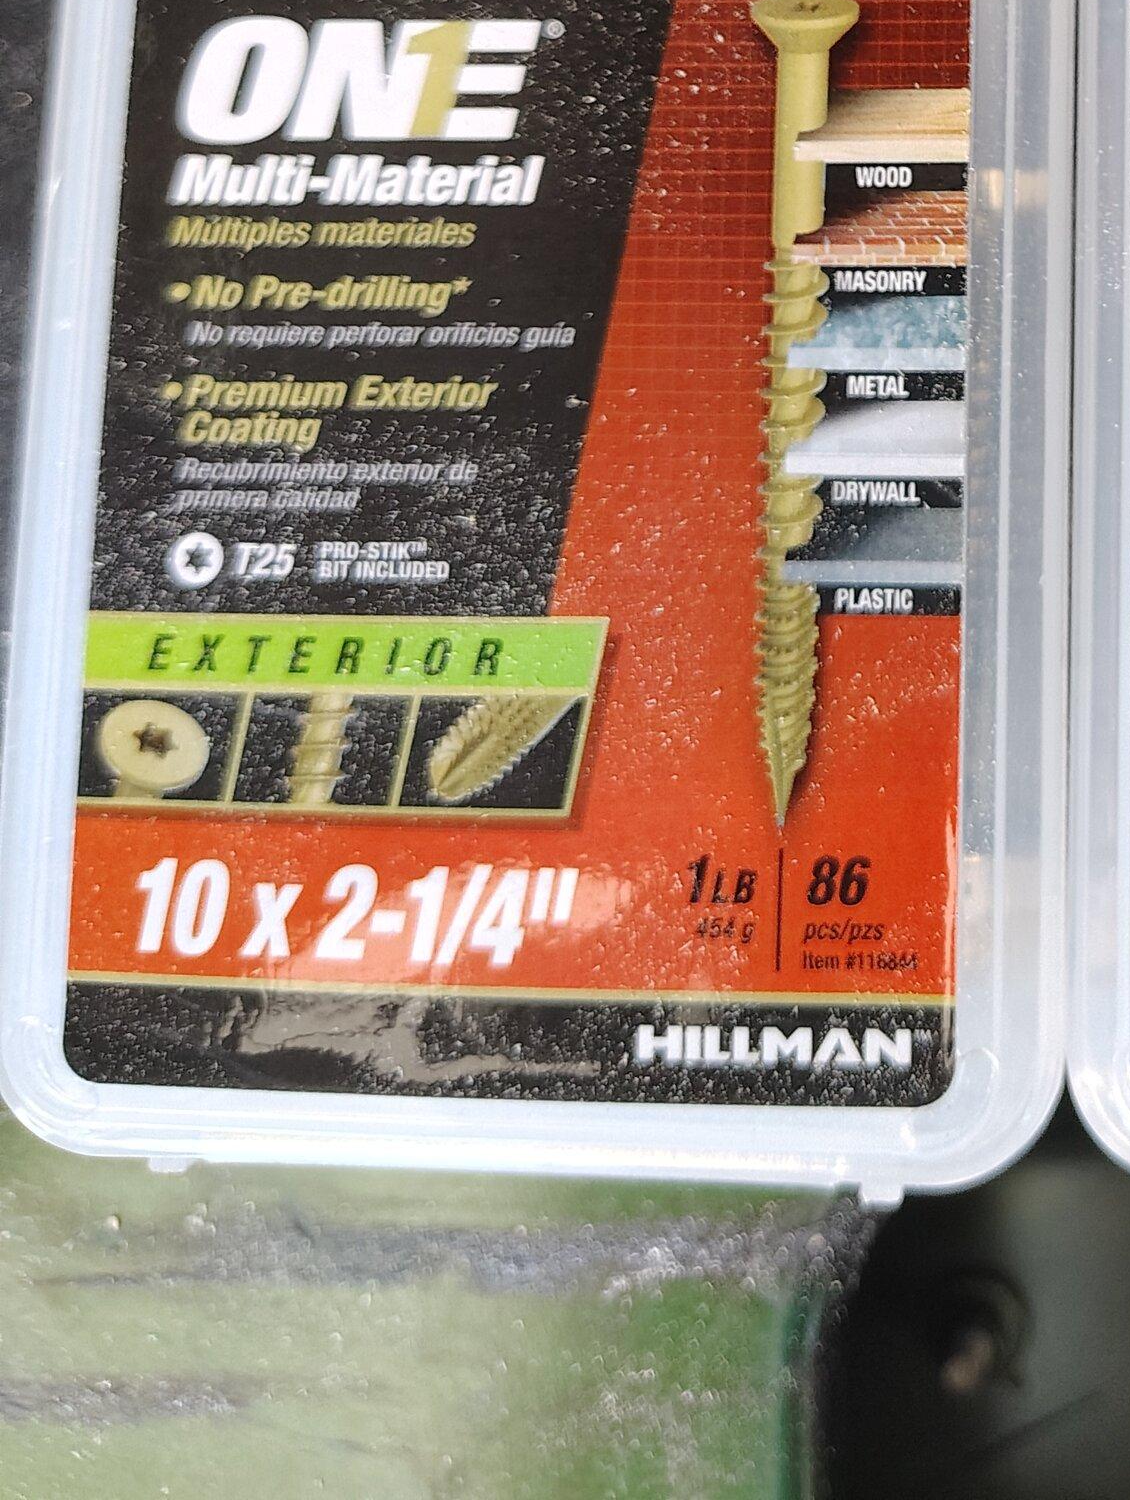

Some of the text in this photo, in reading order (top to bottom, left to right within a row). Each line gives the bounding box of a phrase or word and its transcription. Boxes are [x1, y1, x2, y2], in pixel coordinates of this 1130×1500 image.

[170, 153, 546, 207] Multi-Material
[855, 164, 913, 190] WOOD
[167, 214, 478, 252] Múltiples materiales
[190, 275, 243, 313] No
[833, 269, 928, 295] MASONRY
[186, 320, 224, 346] No
[225, 322, 324, 351] requiere
[325, 320, 424, 350] perforar
[425, 320, 520, 348] orificios
[181, 373, 500, 412] Premium Exterior
[845, 374, 910, 400] METAL
[178, 410, 323, 453] Coating
[173, 458, 480, 486] Recubrimiento exterior de
[830, 480, 922, 506] DRYWALL
[229, 543, 297, 580] T25
[313, 560, 451, 582] BIT INCLUDED
[833, 587, 914, 613] PLASTIC
[147, 631, 505, 678] EXTERIOR
[806, 855, 872, 906] 86
[135, 856, 580, 969] 10 x 2-1/4"
[696, 918, 756, 945] 454 g
[802, 918, 886, 945] pcs/pzs
[802, 950, 840, 970] Item
